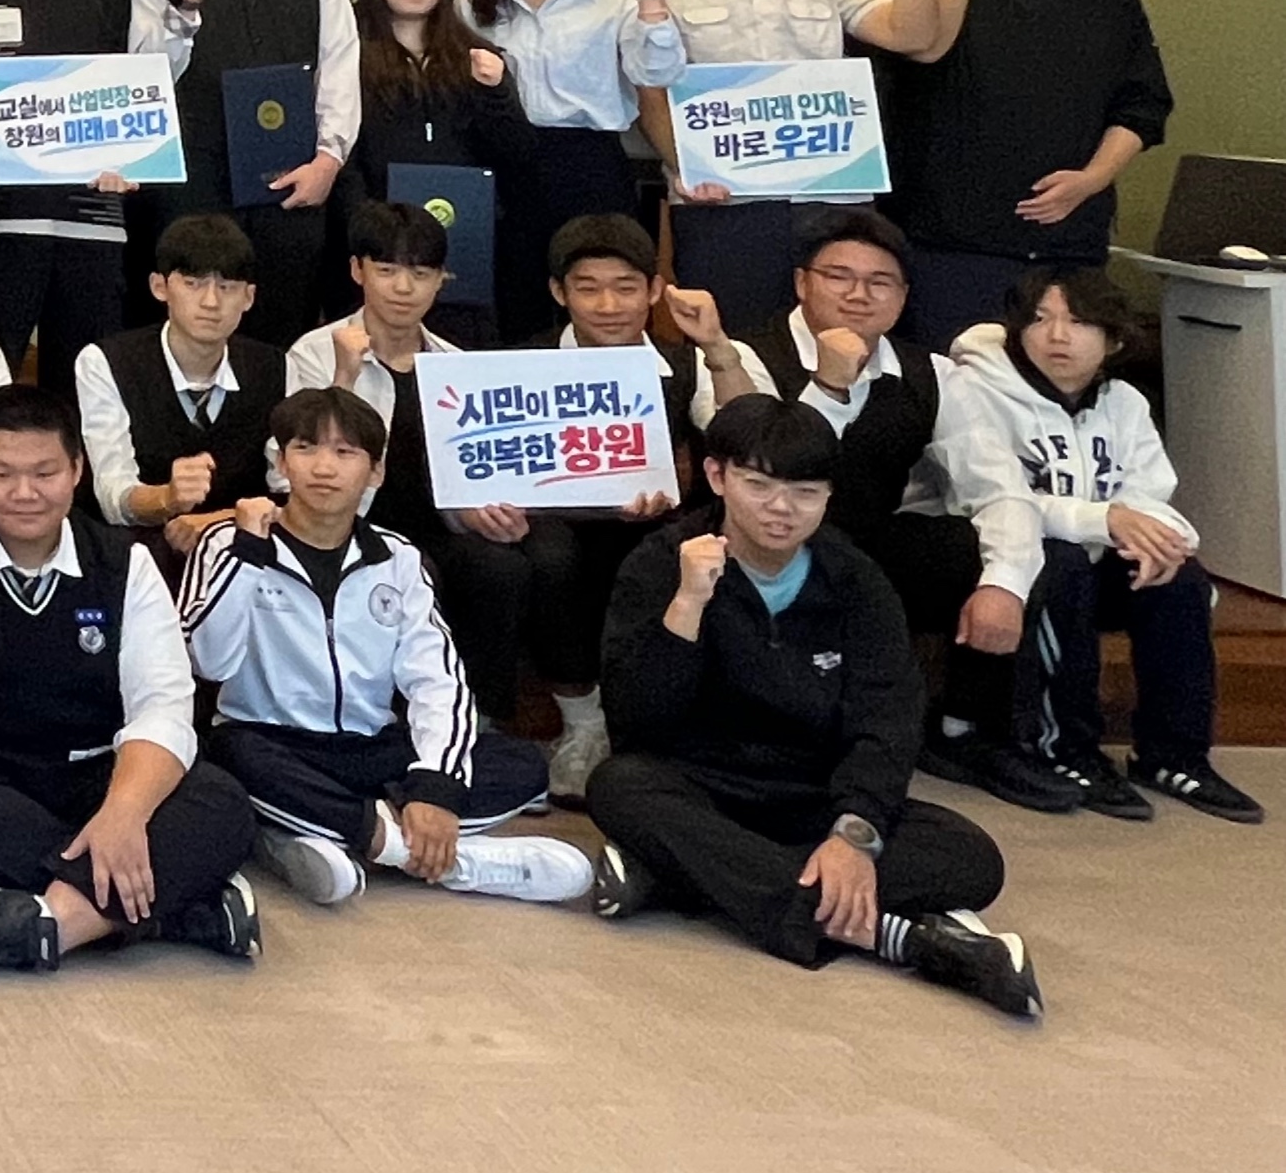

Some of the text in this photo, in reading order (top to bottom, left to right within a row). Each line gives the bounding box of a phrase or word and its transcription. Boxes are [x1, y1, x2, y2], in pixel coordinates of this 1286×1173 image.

[4, 124, 61, 149] 창원의
[121, 108, 169, 139] 잇다
[683, 90, 868, 130] 창원의 미래 인재는
[713, 120, 854, 162] 바로 우리!
[456, 380, 632, 428] 시민이 먼저,
[457, 422, 648, 480] 행복한 창원
